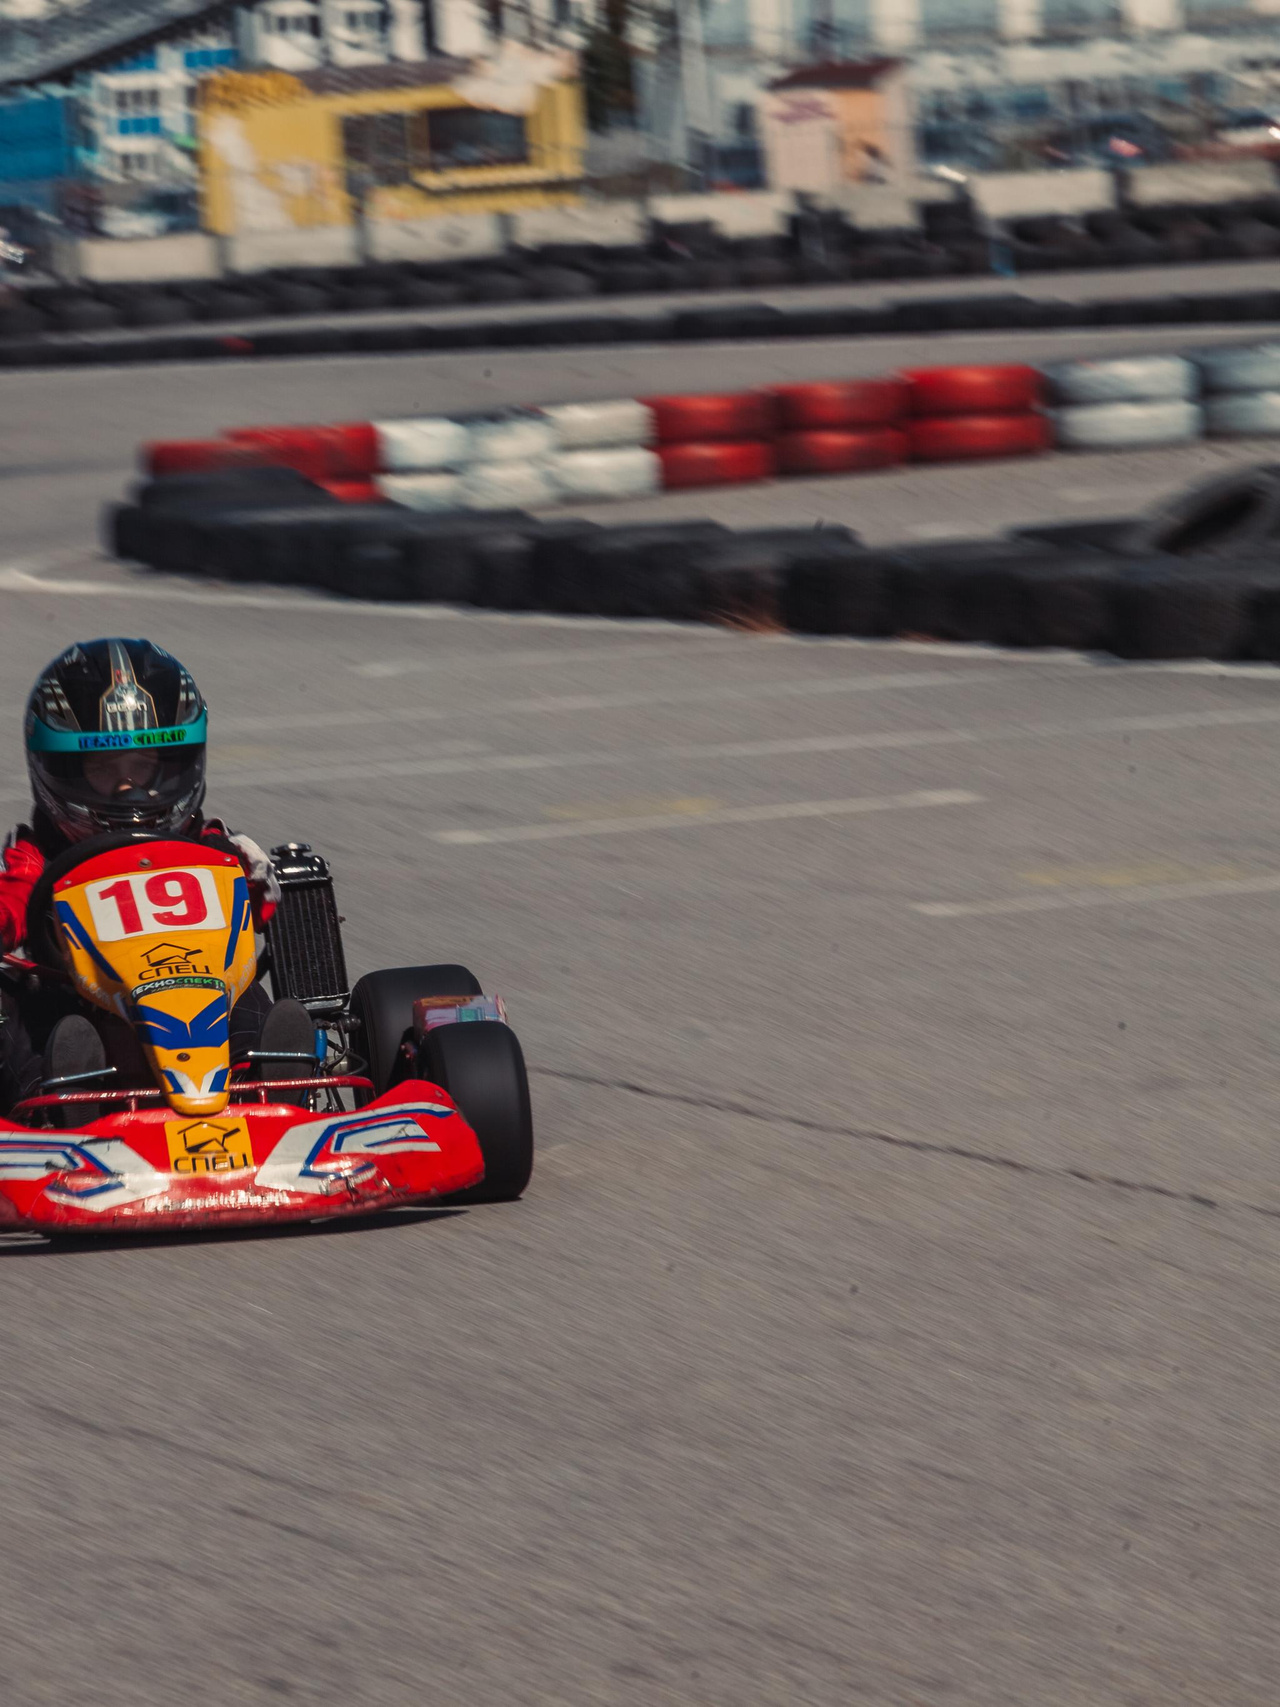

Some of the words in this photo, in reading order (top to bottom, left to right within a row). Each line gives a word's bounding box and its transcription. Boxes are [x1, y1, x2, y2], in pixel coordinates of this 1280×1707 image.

[98, 871, 208, 935] 19
[138, 964, 213, 981] СПЕЦ
[173, 1152, 252, 1174] СПЕЦ
